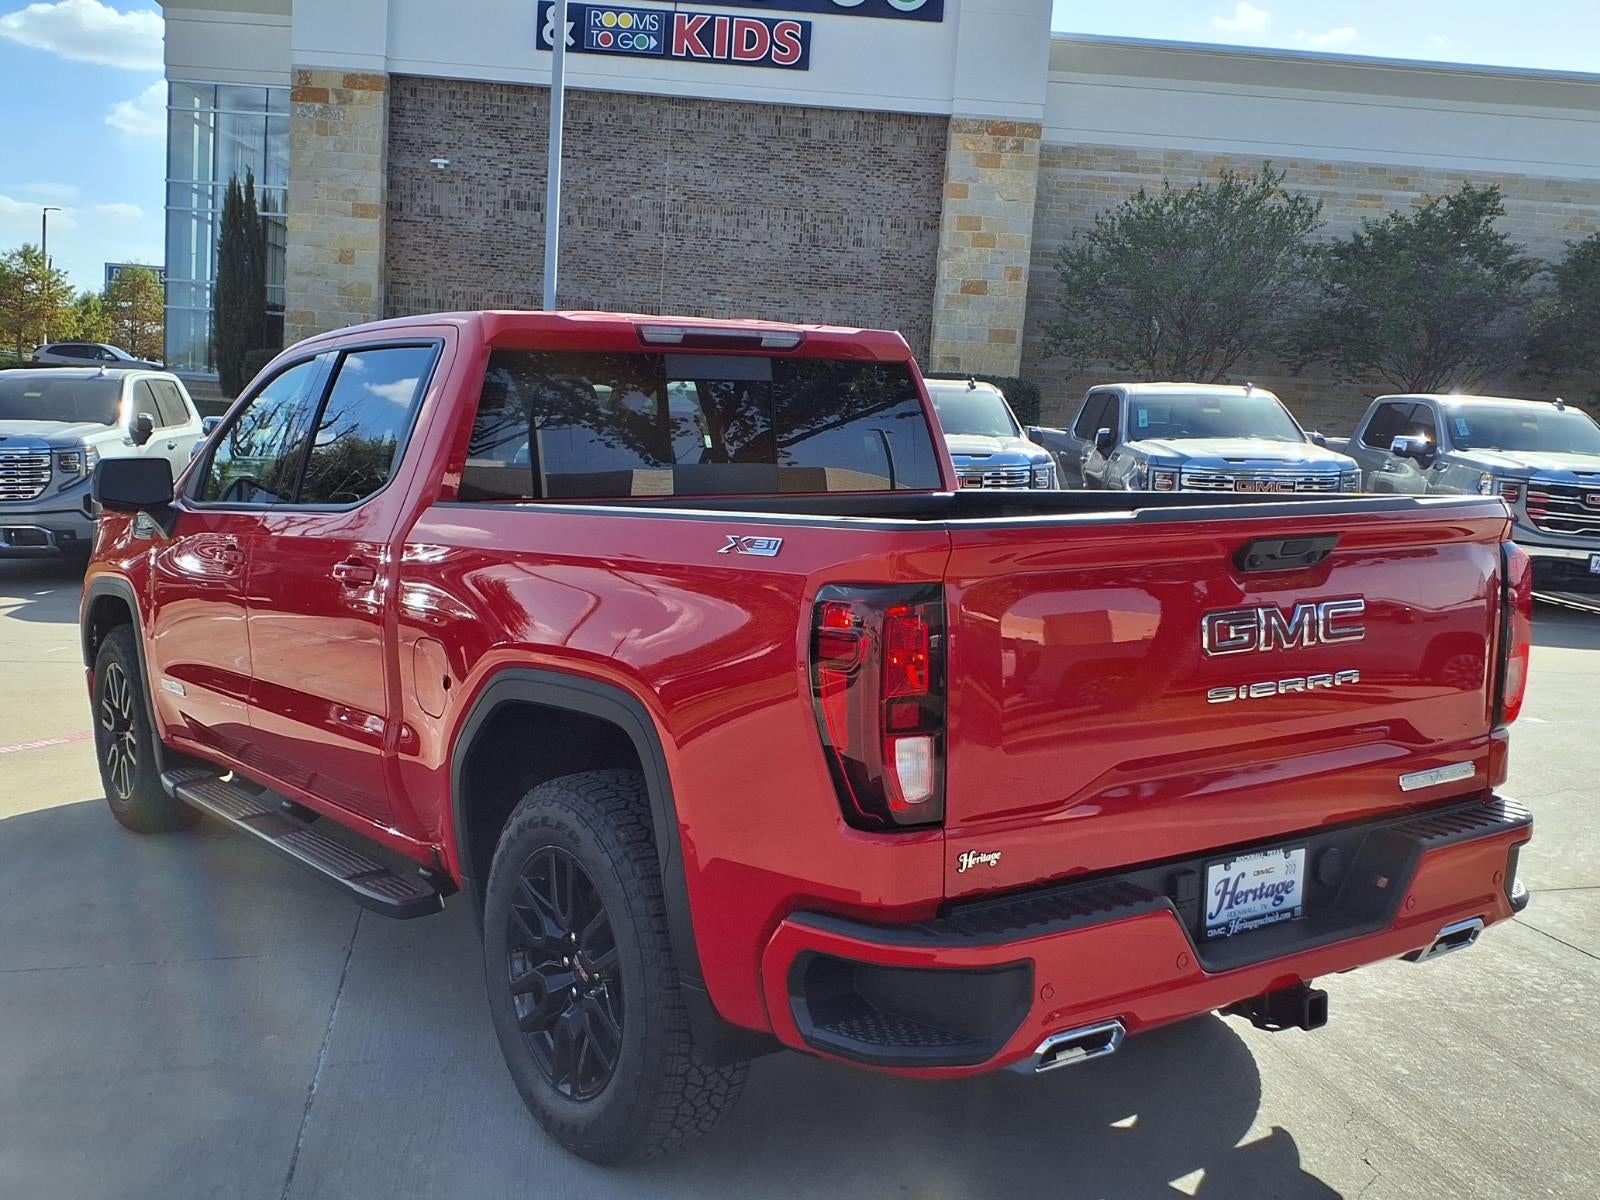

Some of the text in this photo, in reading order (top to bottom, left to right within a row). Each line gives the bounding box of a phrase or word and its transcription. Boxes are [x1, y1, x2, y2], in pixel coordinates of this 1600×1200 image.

[542, 4, 576, 47] &
[590, 10, 659, 31] ROOMS
[590, 30, 649, 50] TO GO
[672, 13, 802, 65] KIDS
[1236, 480, 1295, 493] GMC
[717, 534, 783, 557] X31
[1202, 598, 1366, 656] GMC
[1207, 669, 1361, 704] SIERRA
[957, 849, 1002, 873] Heritage
[1253, 867, 1275, 877] GMC
[1208, 872, 1295, 920] Heritage
[1207, 926, 1226, 937] GMC
